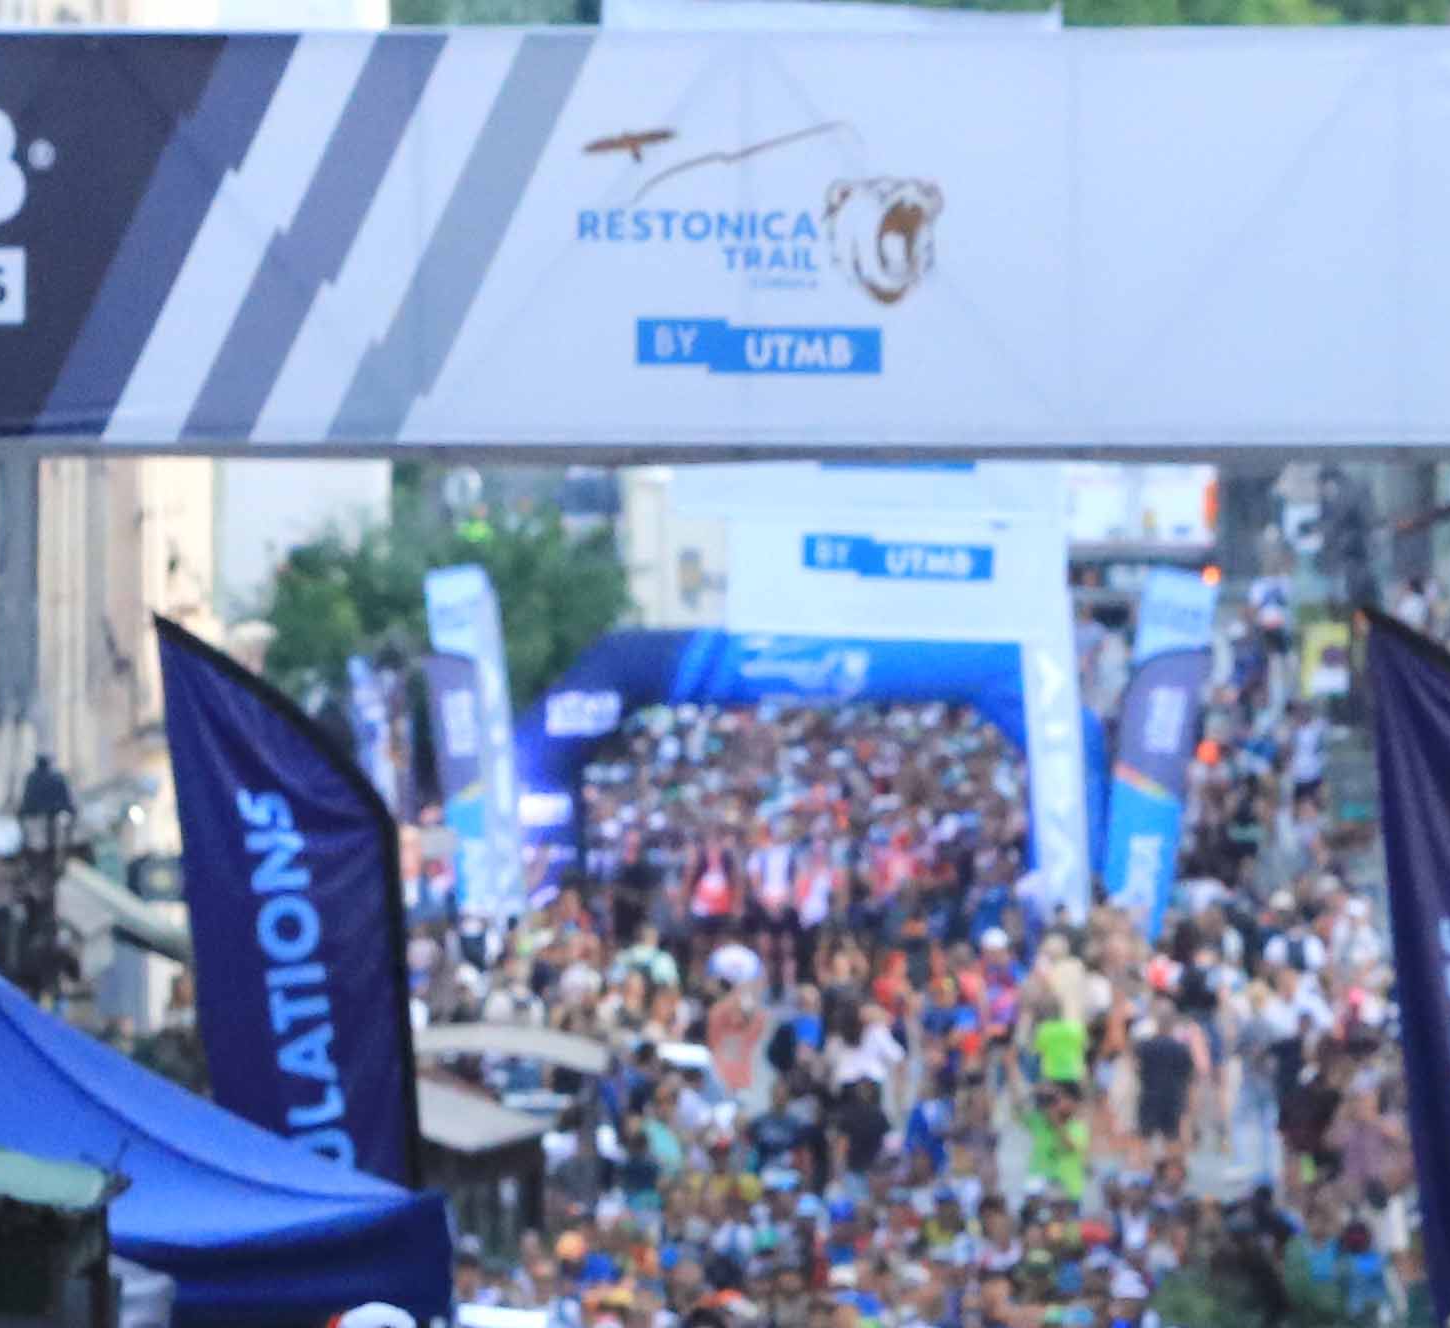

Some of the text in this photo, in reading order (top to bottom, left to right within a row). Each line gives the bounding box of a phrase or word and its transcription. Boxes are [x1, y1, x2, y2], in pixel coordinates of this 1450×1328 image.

[576, 209, 819, 243] RESTONICA
[723, 246, 819, 273] TRAIL
[653, 325, 854, 370] BY UTMB
